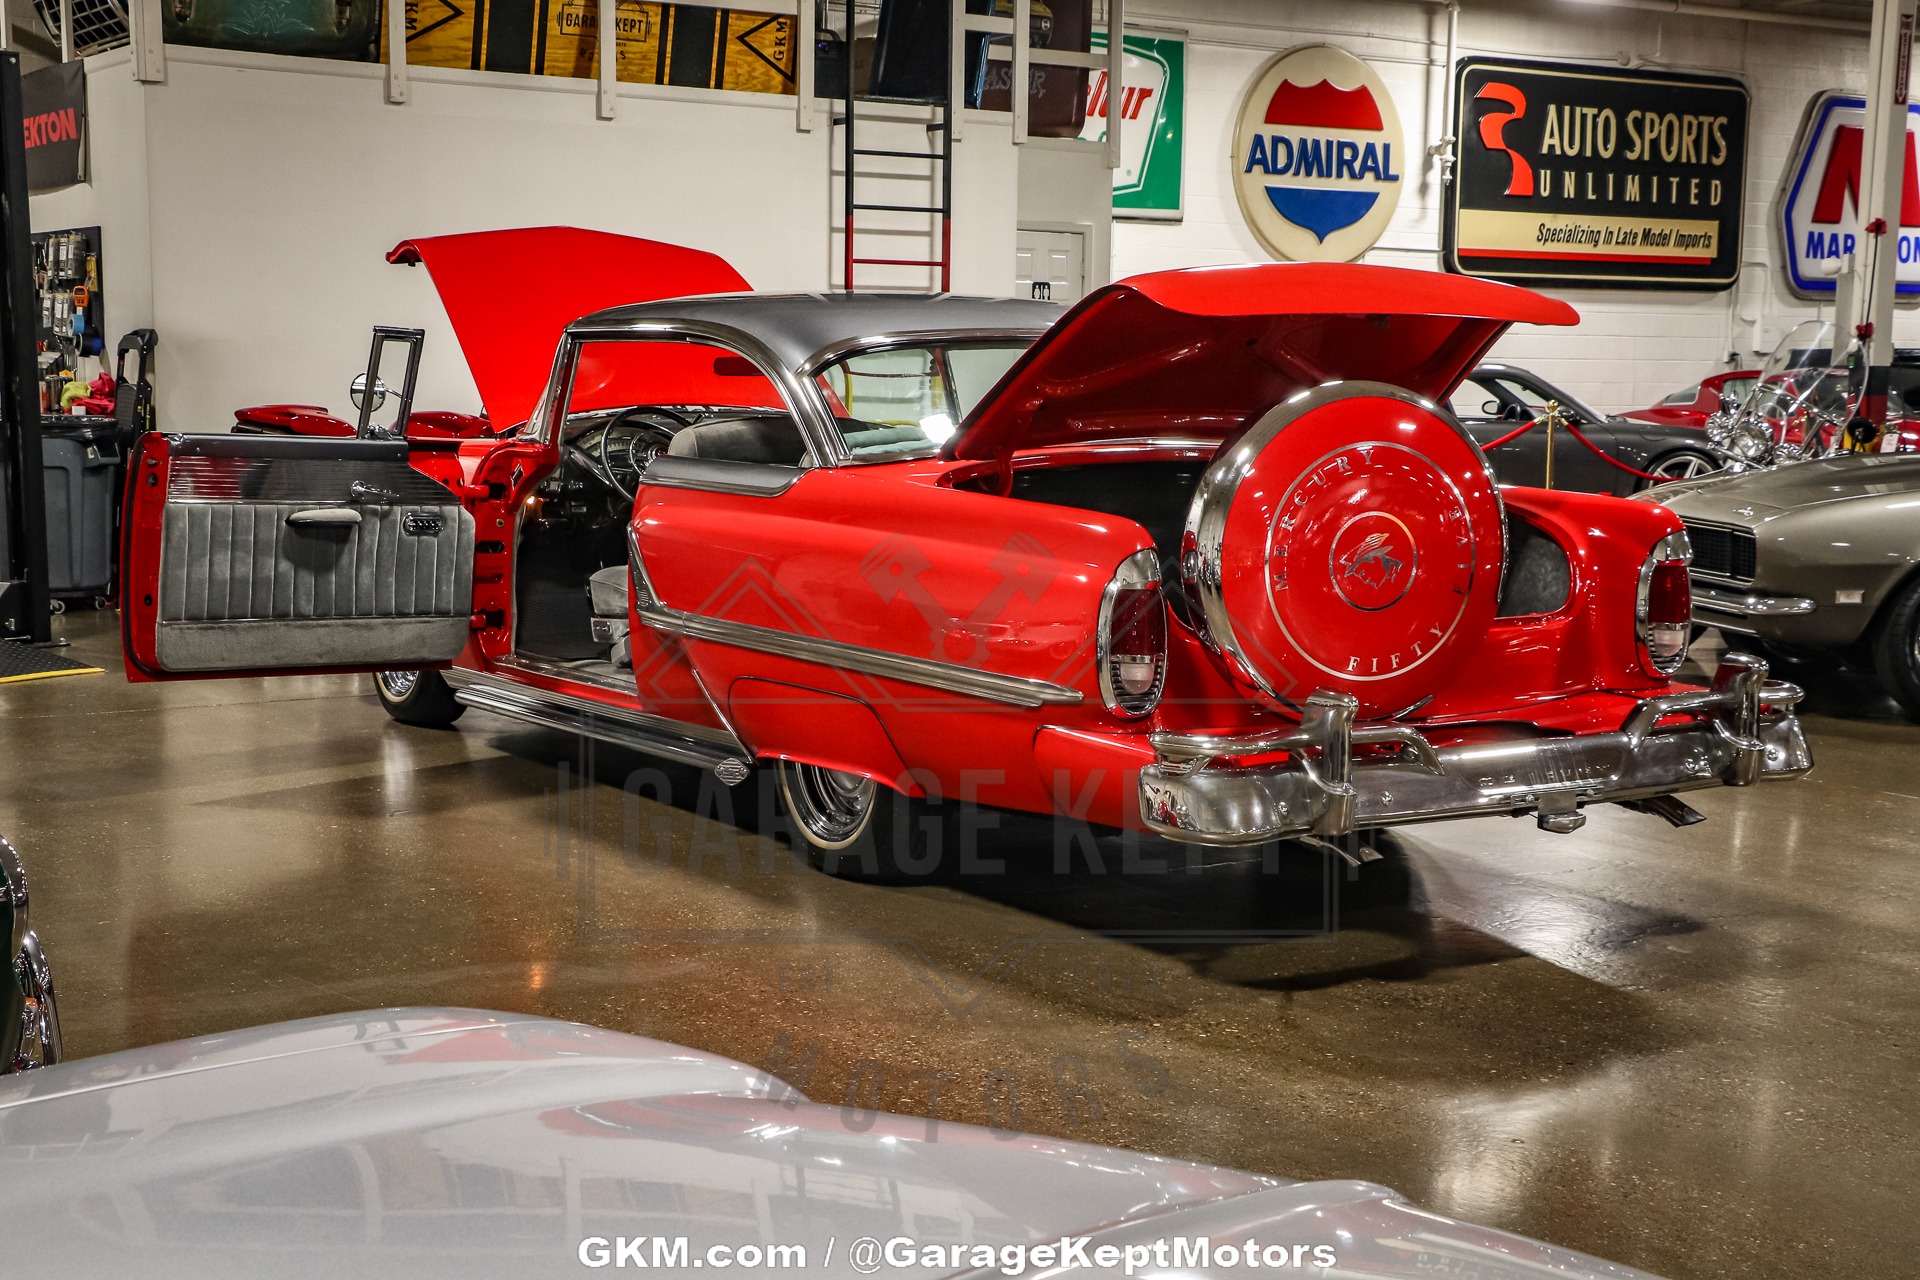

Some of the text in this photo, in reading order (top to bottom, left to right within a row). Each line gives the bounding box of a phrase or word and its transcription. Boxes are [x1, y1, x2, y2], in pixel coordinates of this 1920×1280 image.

[565, 13, 643, 34] GARA KEPT
[773, 19, 789, 61] GKM
[23, 107, 77, 149] EKTON
[1541, 103, 1728, 167] AUTO SPORTS
[1244, 133, 1400, 182] ADMIRAL
[1539, 168, 1722, 206] UNLIMITED
[1536, 222, 1713, 250] Specializing In Late Model Imports
[1273, 449, 1375, 593] MERCURY
[1346, 621, 1443, 673] FIFTY
